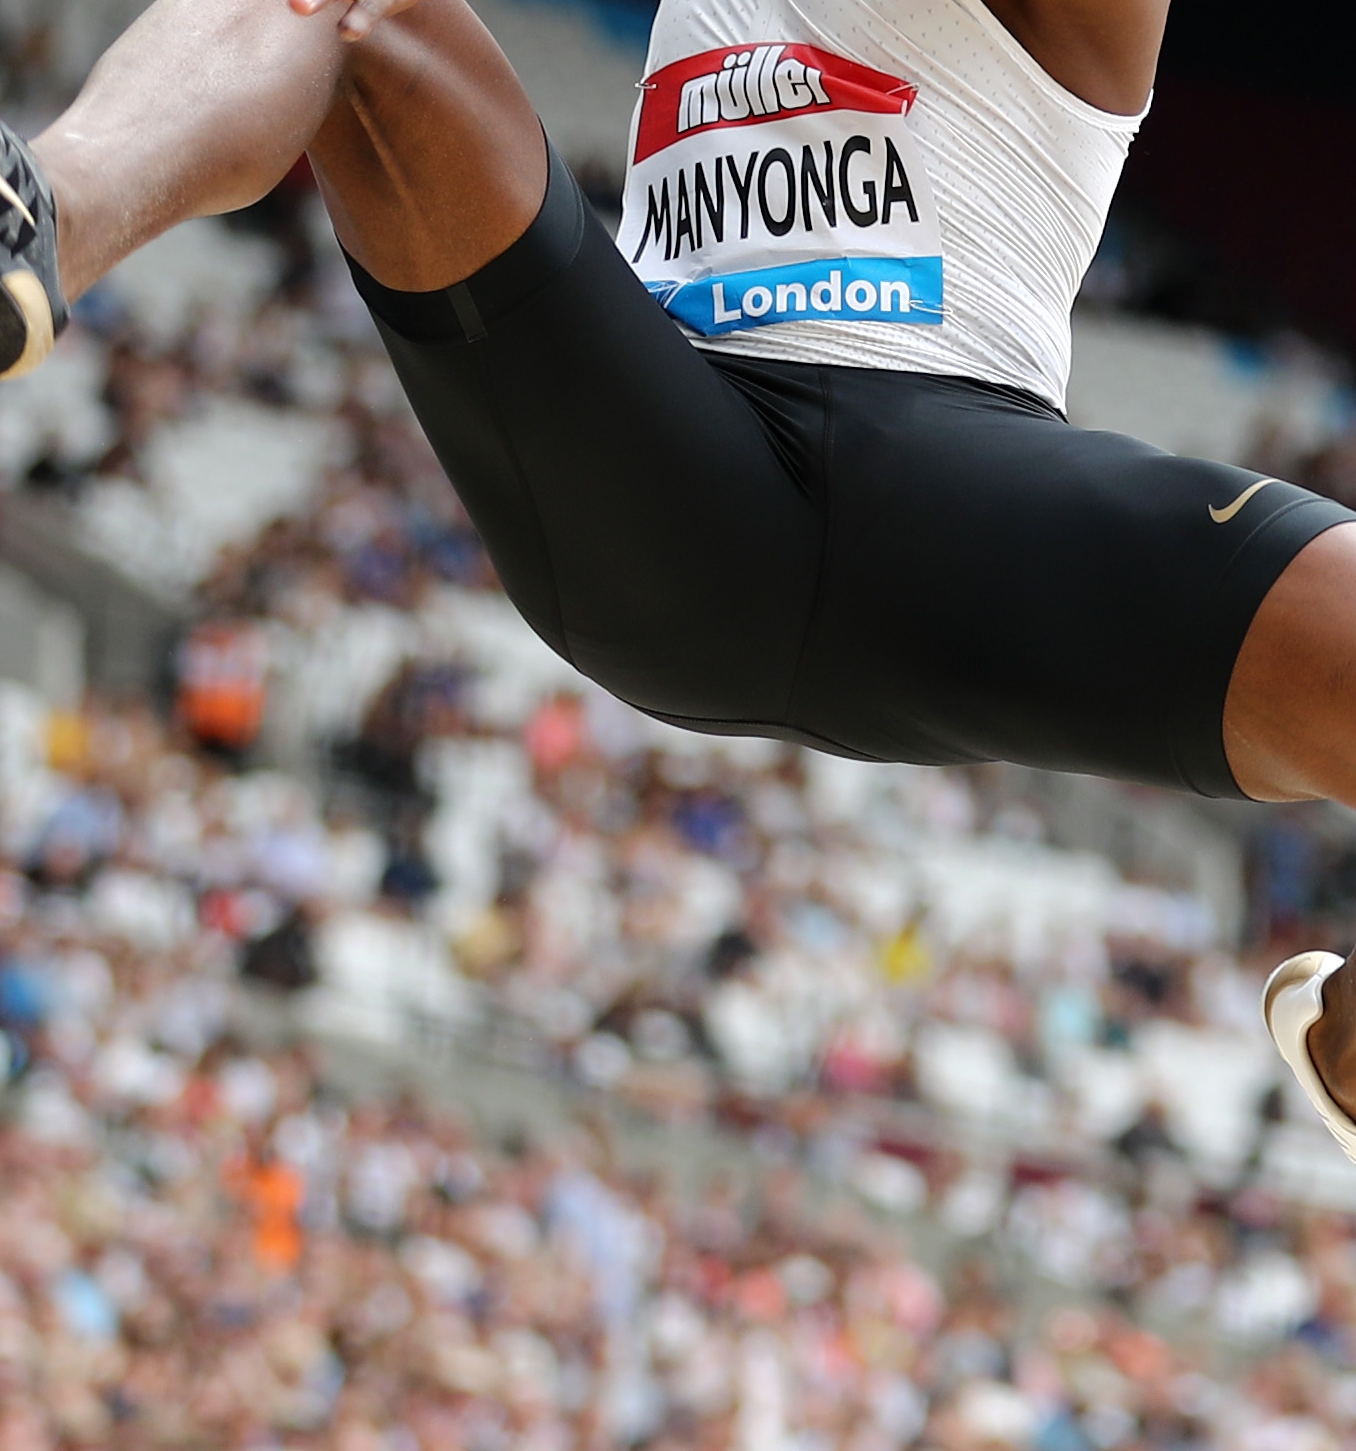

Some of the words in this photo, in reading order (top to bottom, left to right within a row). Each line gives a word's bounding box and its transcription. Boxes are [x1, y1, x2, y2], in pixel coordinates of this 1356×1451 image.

[677, 45, 832, 133] müller
[633, 135, 919, 263] MANYONGA
[712, 270, 911, 324] London
